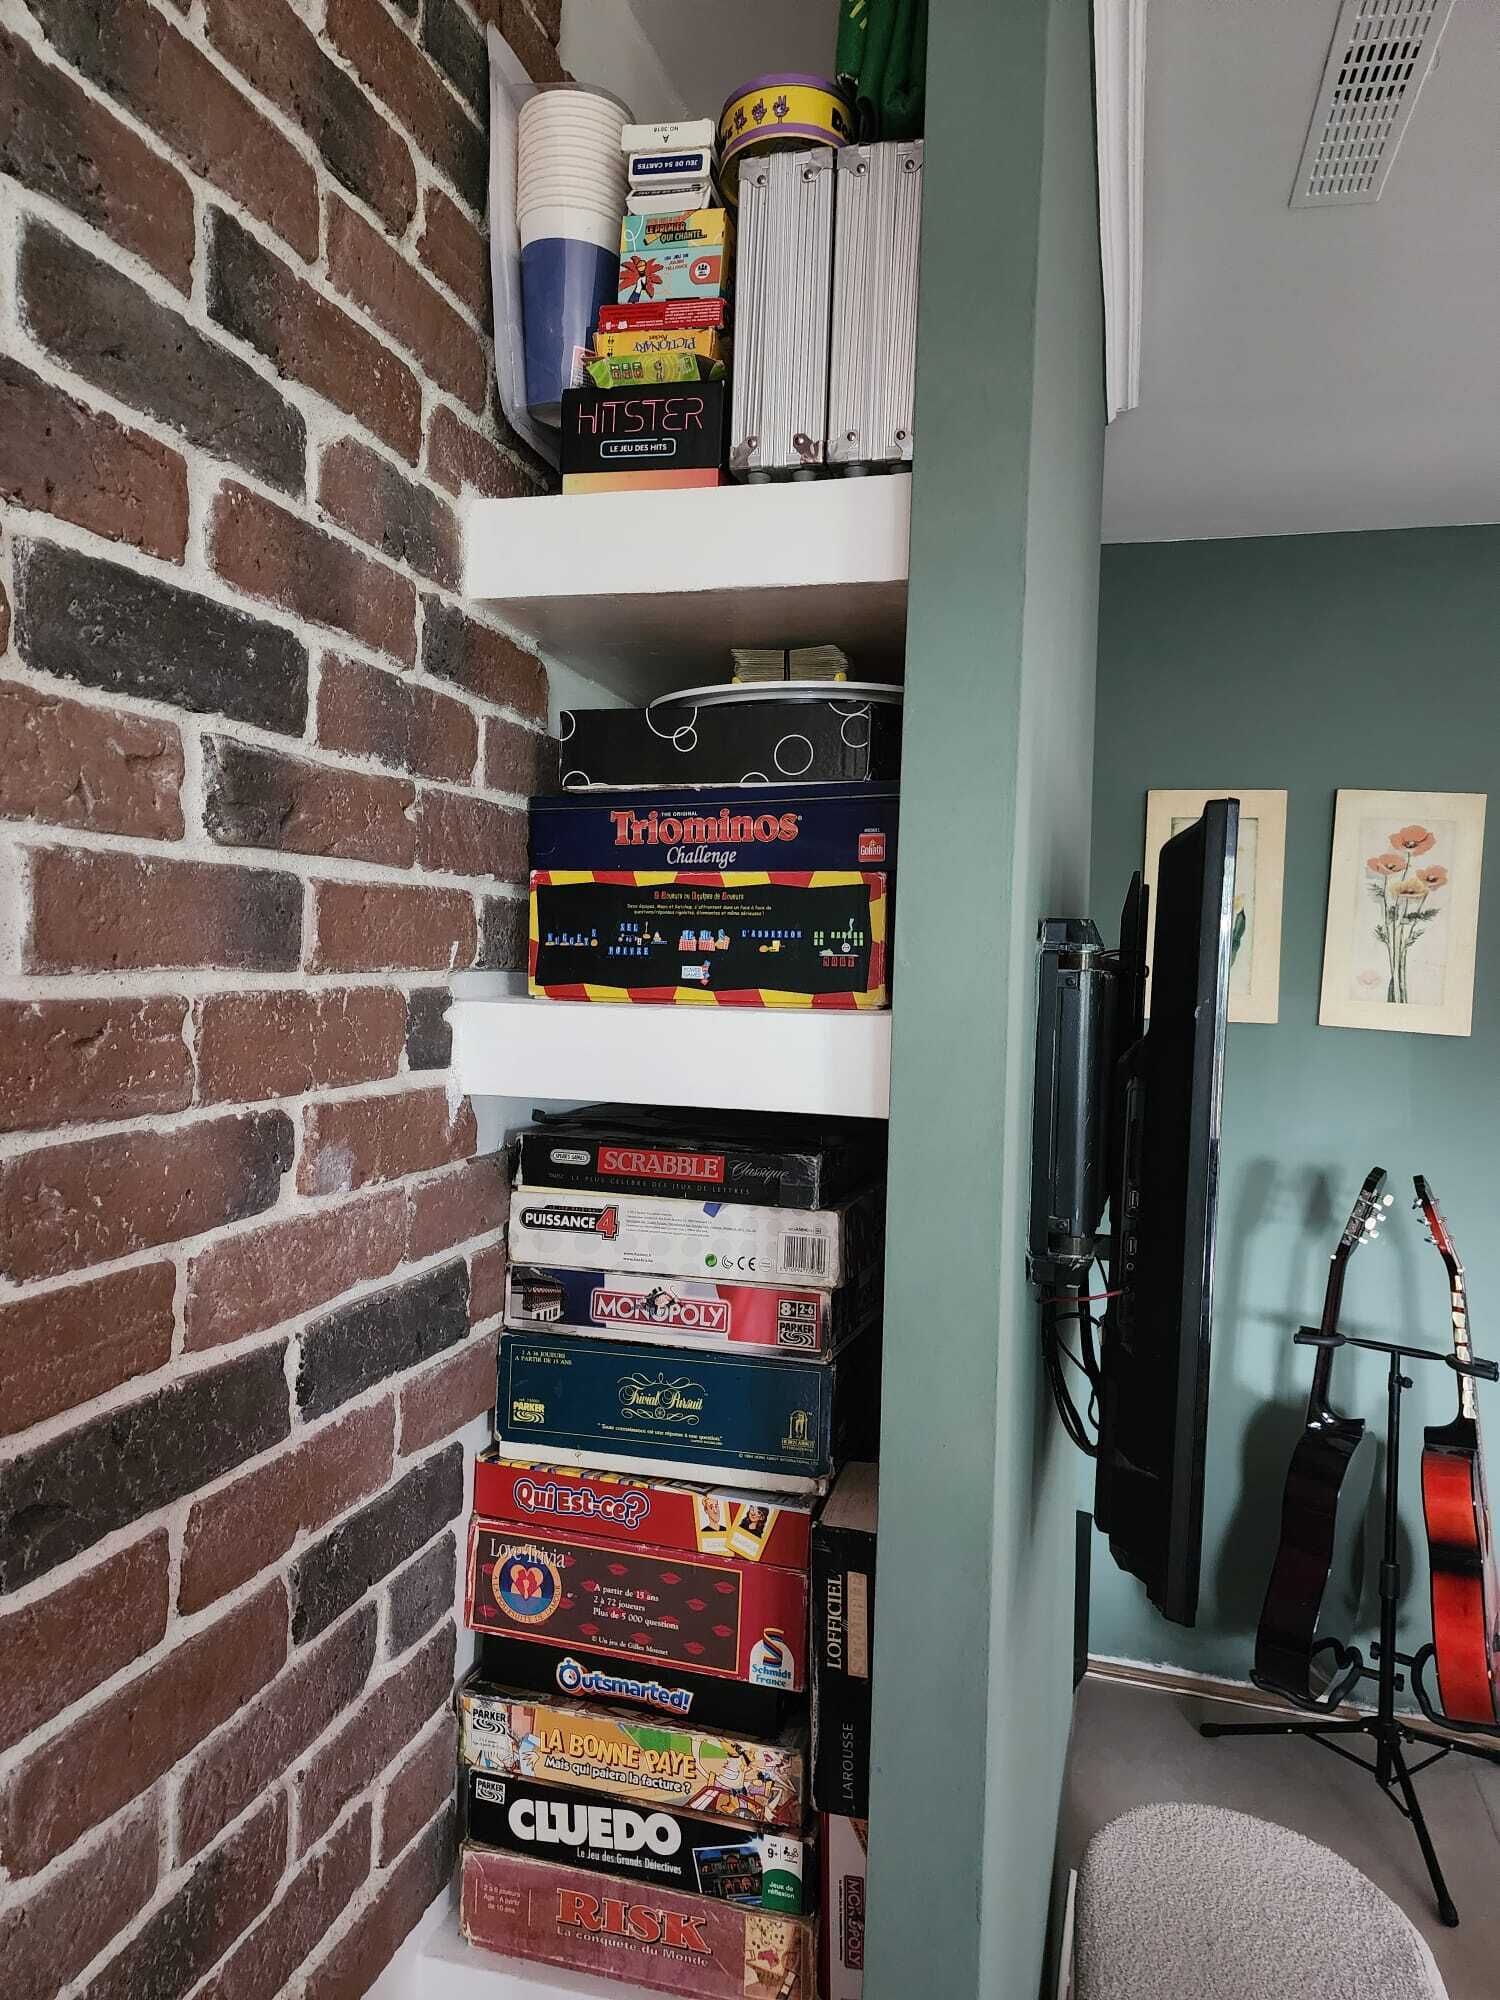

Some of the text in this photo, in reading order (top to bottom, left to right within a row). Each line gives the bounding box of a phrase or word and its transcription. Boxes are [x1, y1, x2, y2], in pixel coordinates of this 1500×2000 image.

[663, 134, 670, 143] A
[647, 222, 686, 234] LE PREMIER
[661, 232, 673, 241] QUI
[633, 336, 696, 353] PICTIONARY
[578, 398, 704, 434] HITSTER
[610, 808, 799, 845] Triominos
[666, 846, 737, 868] Challenge
[604, 1151, 718, 1178] SCRABBLE
[730, 1160, 790, 1184] Classique
[525, 1213, 596, 1229] PUISSANCE
[596, 1207, 617, 1236] 4
[597, 1294, 724, 1327] MONOPOLY
[781, 1302, 795, 1316] 8+
[800, 1305, 813, 1315] 2-6
[780, 1322, 814, 1333] PARKER
[513, 1401, 544, 1412] PARKER
[619, 1384, 703, 1410] Trivial Pursuit
[516, 1481, 646, 1525] Qui Est-ce?
[490, 1538, 566, 1568] Love Trivia
[602, 1586, 623, 1596] partir
[625, 1588, 634, 1597] de
[636, 1591, 644, 1599] 15
[607, 1598, 616, 1606] 72
[618, 1600, 646, 1611] joueurs
[593, 1608, 608, 1617] Plus
[621, 1612, 626, 1620] 5
[628, 1614, 643, 1623] 000
[645, 1619, 679, 1630] questions
[608, 1638, 618, 1646] jeu
[628, 1642, 644, 1651] Gilles
[752, 1664, 791, 1679] Schmidt
[756, 1674, 786, 1686] France
[557, 1659, 692, 1711] Outsmarted!
[473, 1708, 506, 1722] PARKER
[540, 1729, 697, 1779] LA BONNE PAYE
[842, 1722, 854, 1799] LAROUSSE
[478, 1780, 504, 1792] PARKER
[545, 1756, 690, 1794] Mais qui paiera la facture ?
[508, 1798, 682, 1856] CLUEDO
[577, 1847, 682, 1874] Le Jeu des Grands Détectives
[768, 1848, 778, 1858] 9+
[768, 1888, 794, 1899] réflexion
[769, 1882, 784, 1890] Jeux
[556, 1888, 712, 1954] RISK
[557, 1926, 570, 1937] La
[641, 1946, 657, 1955] du
[663, 1949, 708, 1966] Monde
